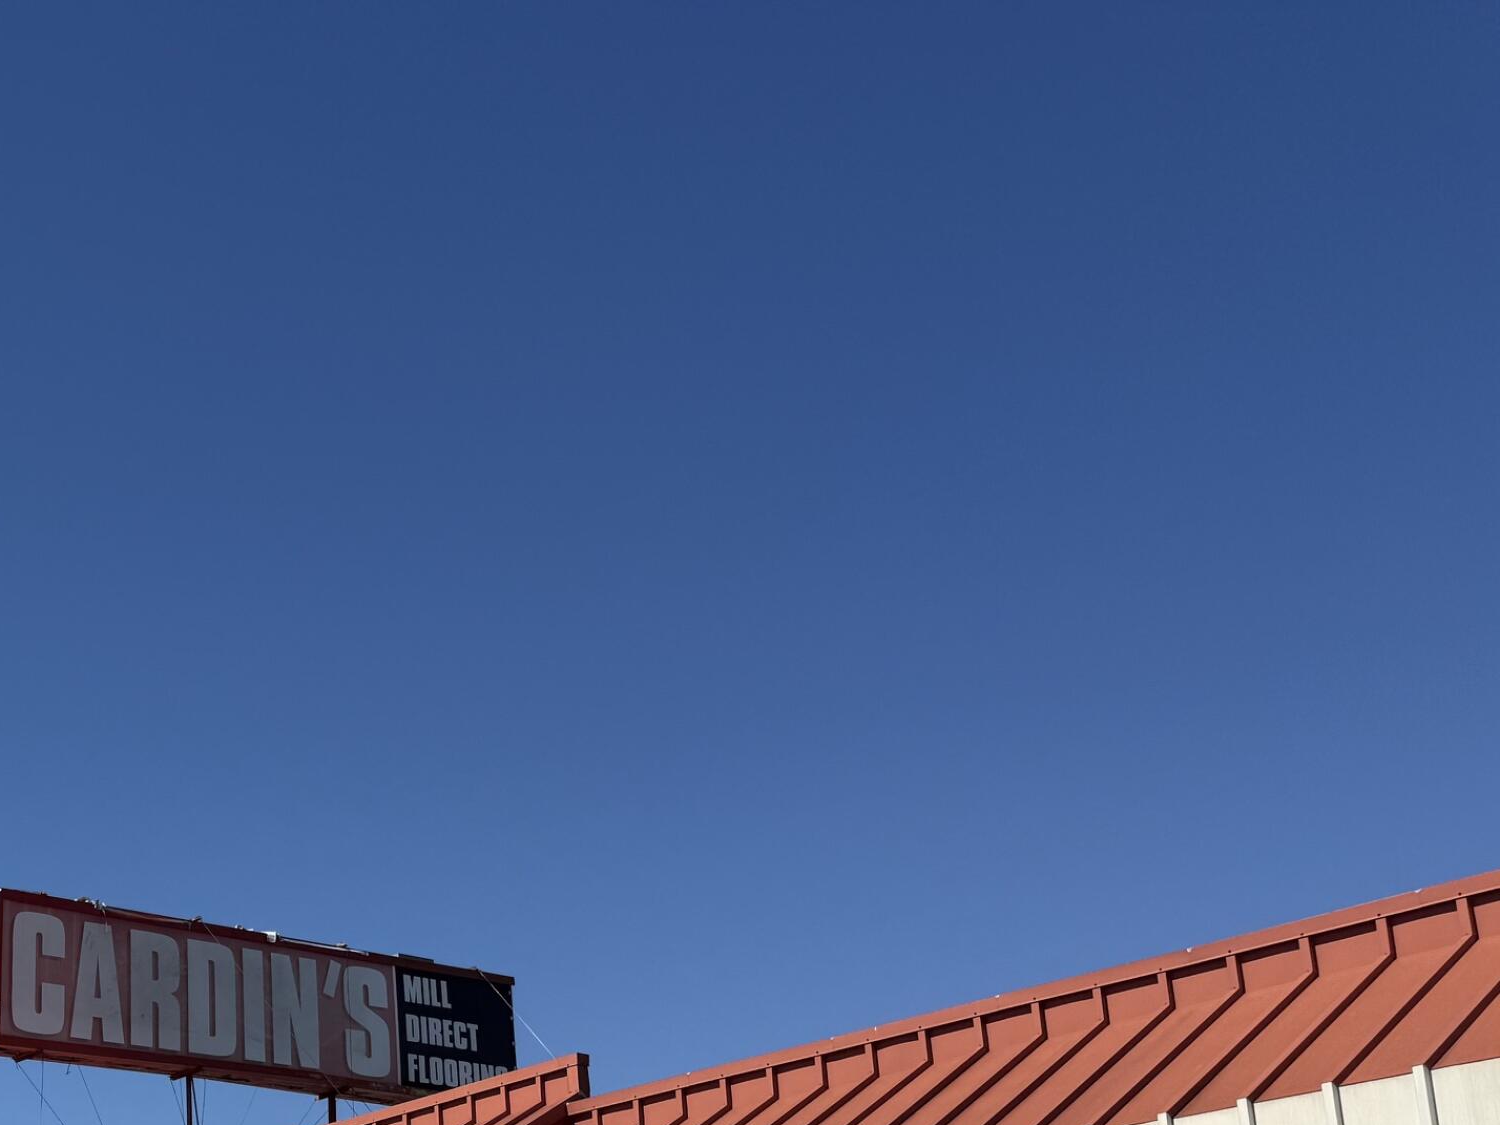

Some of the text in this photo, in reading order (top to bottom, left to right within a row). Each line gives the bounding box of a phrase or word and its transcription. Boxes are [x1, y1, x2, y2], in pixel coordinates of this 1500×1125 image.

[11, 910, 391, 1080] CARDIN'S
[403, 974, 452, 1009] MILL
[405, 1013, 479, 1052] DIRECT
